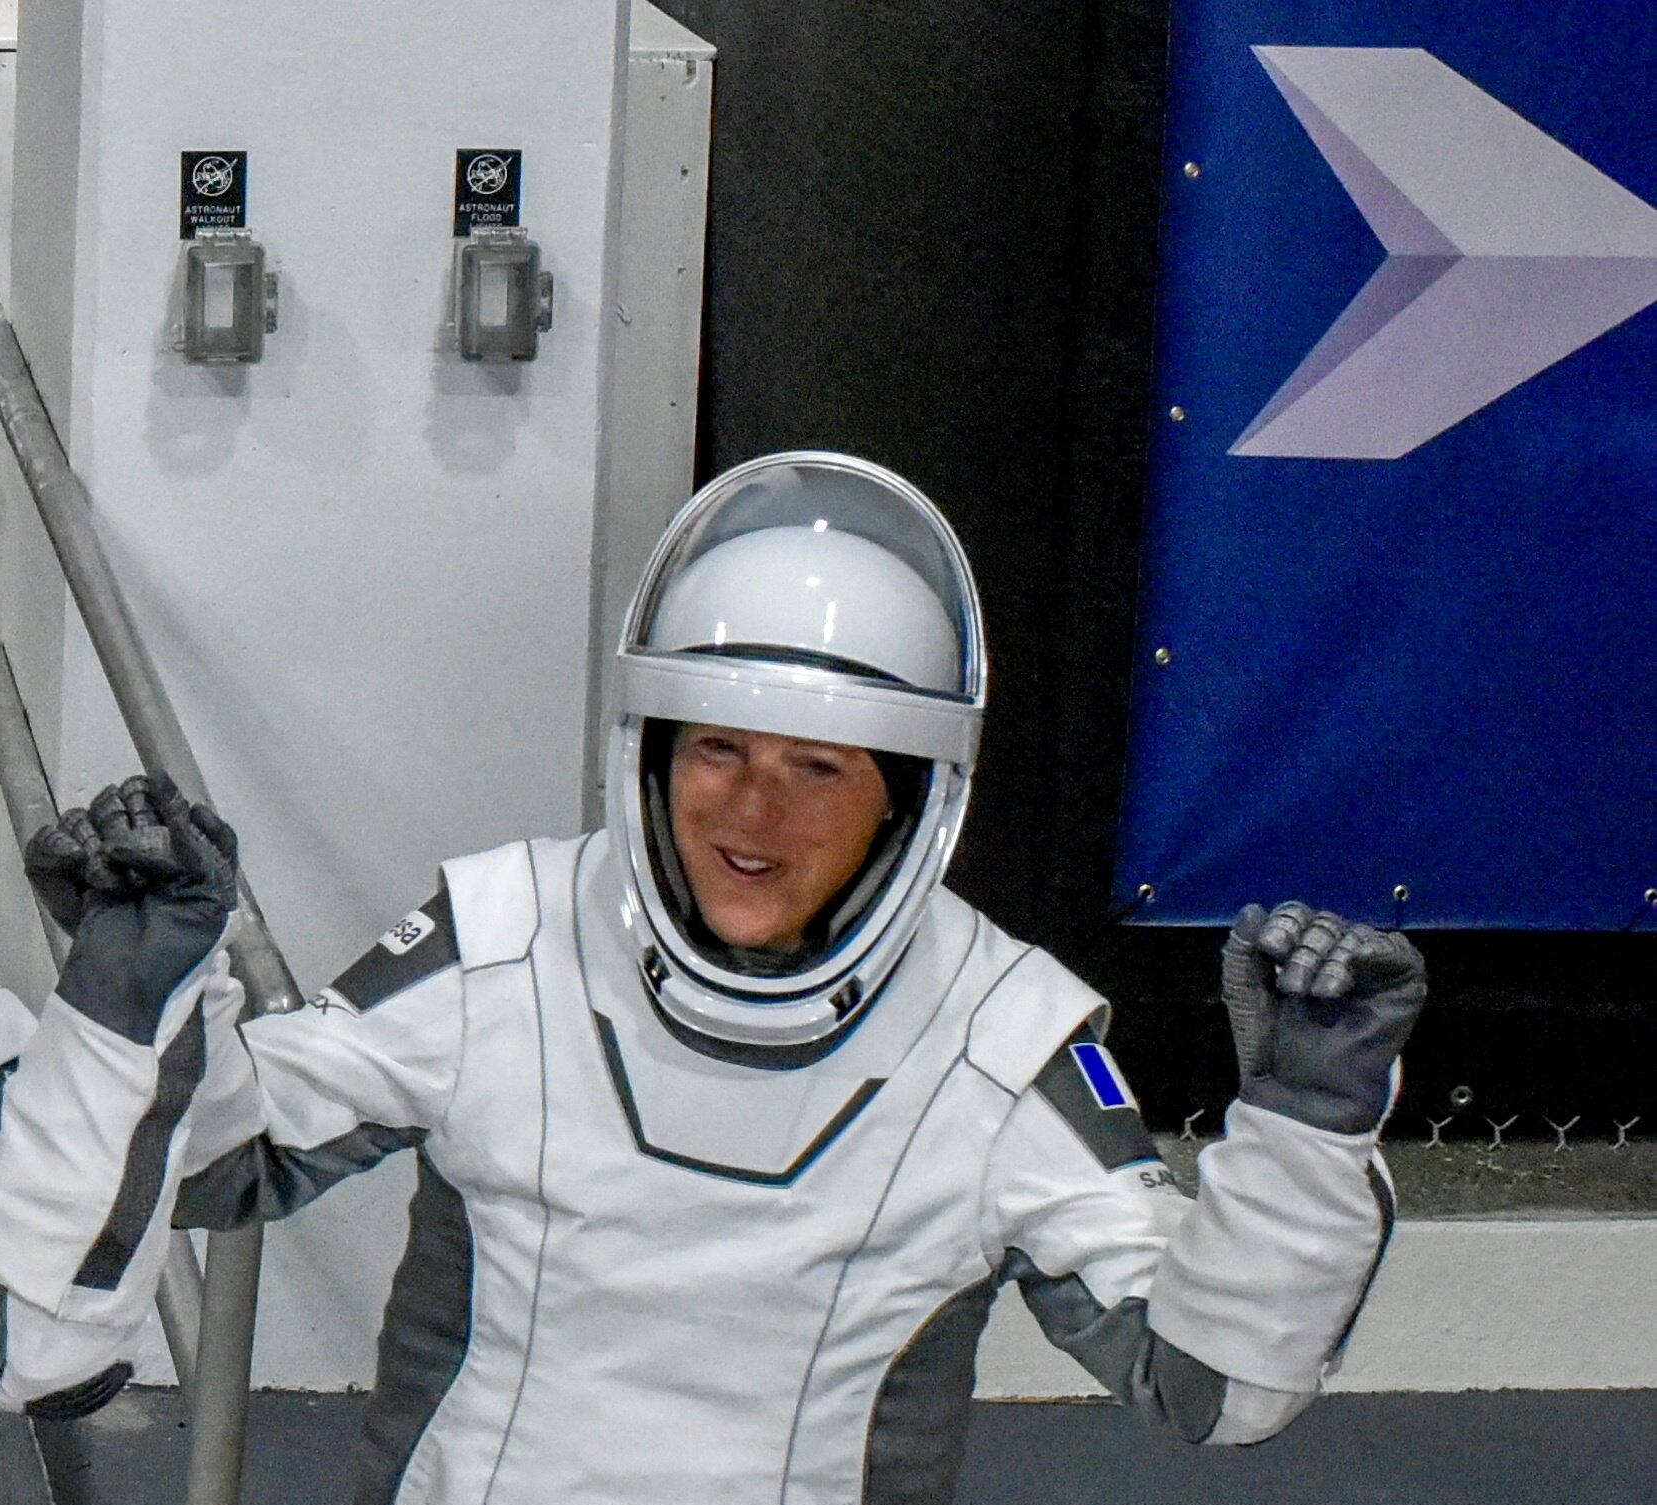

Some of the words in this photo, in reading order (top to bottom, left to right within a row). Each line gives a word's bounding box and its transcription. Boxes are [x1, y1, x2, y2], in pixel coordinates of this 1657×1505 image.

[185, 205, 241, 214] ASTRONAUT
[459, 203, 515, 212] ASTRONAUT
[190, 215, 236, 224] WALKOUT
[471, 213, 503, 222] FLOOD
